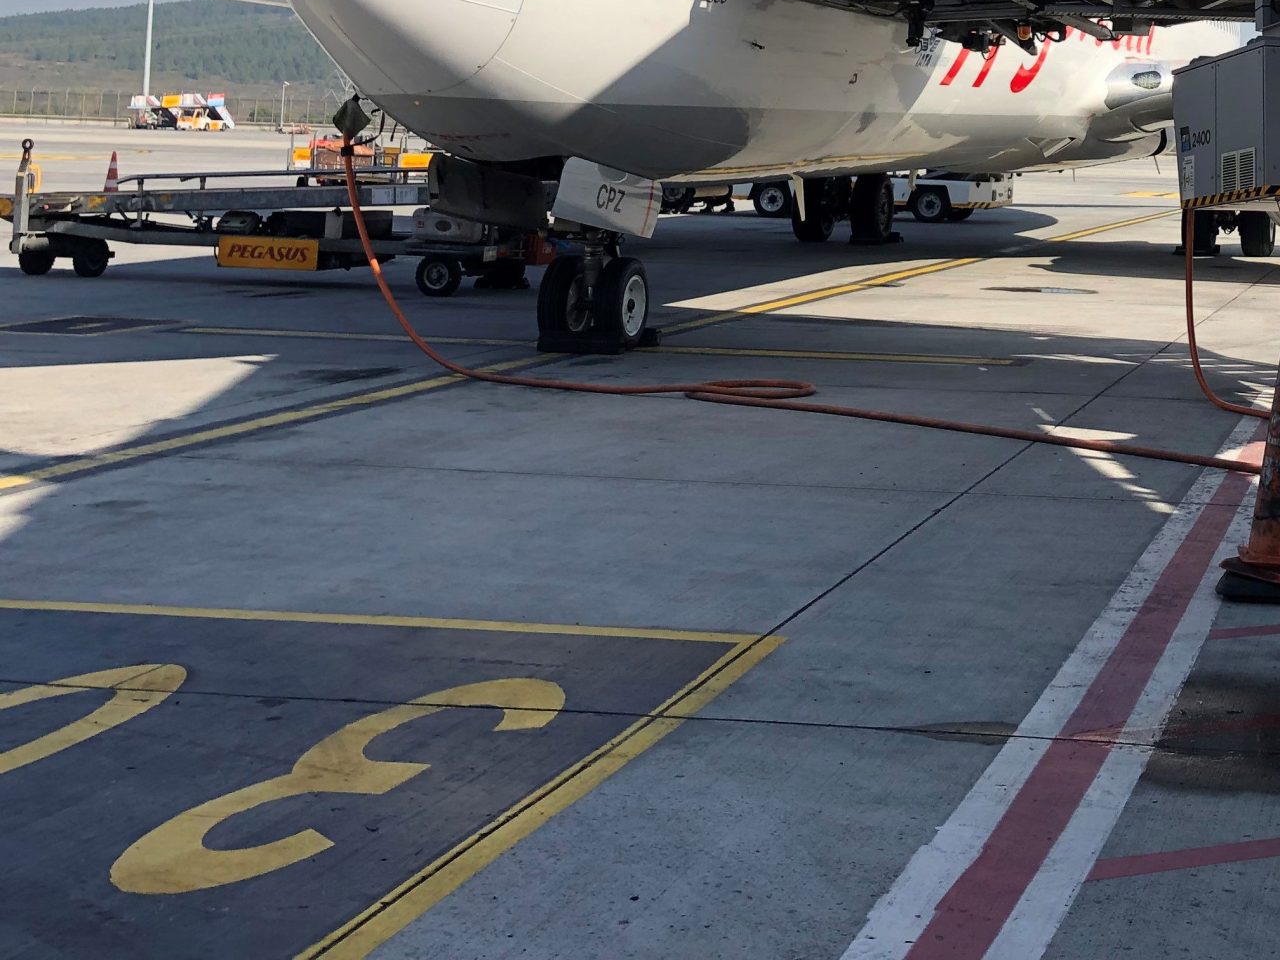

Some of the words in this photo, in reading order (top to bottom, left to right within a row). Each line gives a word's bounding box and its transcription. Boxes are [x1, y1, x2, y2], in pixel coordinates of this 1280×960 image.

[1192, 130, 1210, 147] 2400
[597, 184, 625, 213] CPZ
[227, 244, 309, 263] PEGASUS
